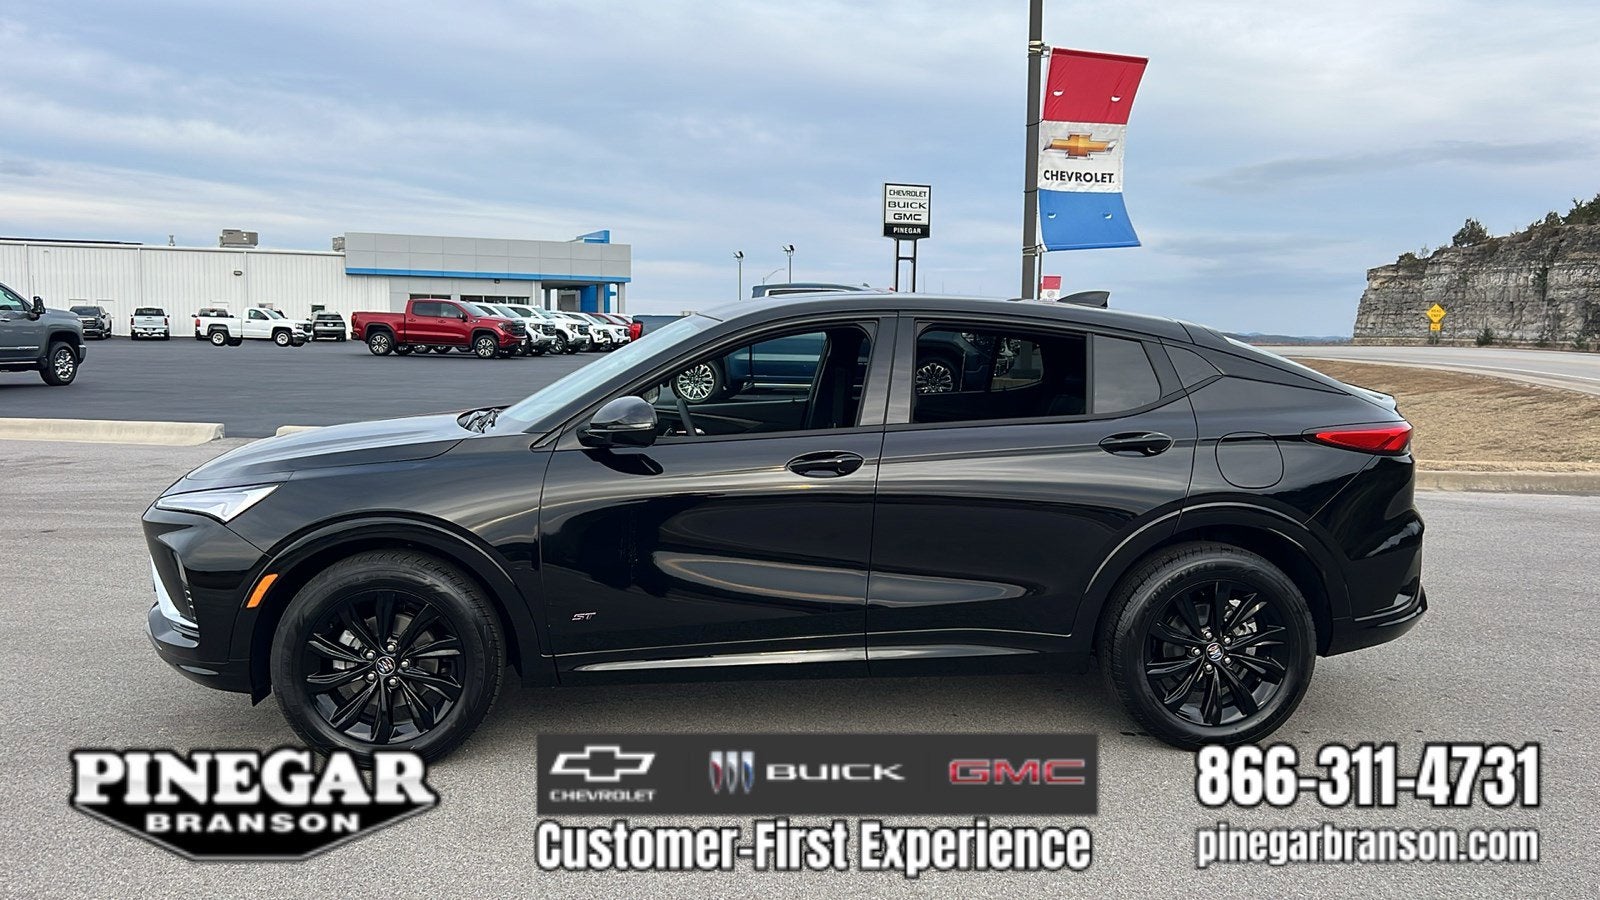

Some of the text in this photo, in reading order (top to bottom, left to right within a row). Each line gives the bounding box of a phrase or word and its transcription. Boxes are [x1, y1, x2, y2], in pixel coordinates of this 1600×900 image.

[1043, 169, 1115, 184] CHEVROLET
[888, 189, 927, 198] CHEVROLET
[888, 201, 927, 209] BUICK
[893, 212, 922, 221] GMC
[571, 611, 597, 621] ST
